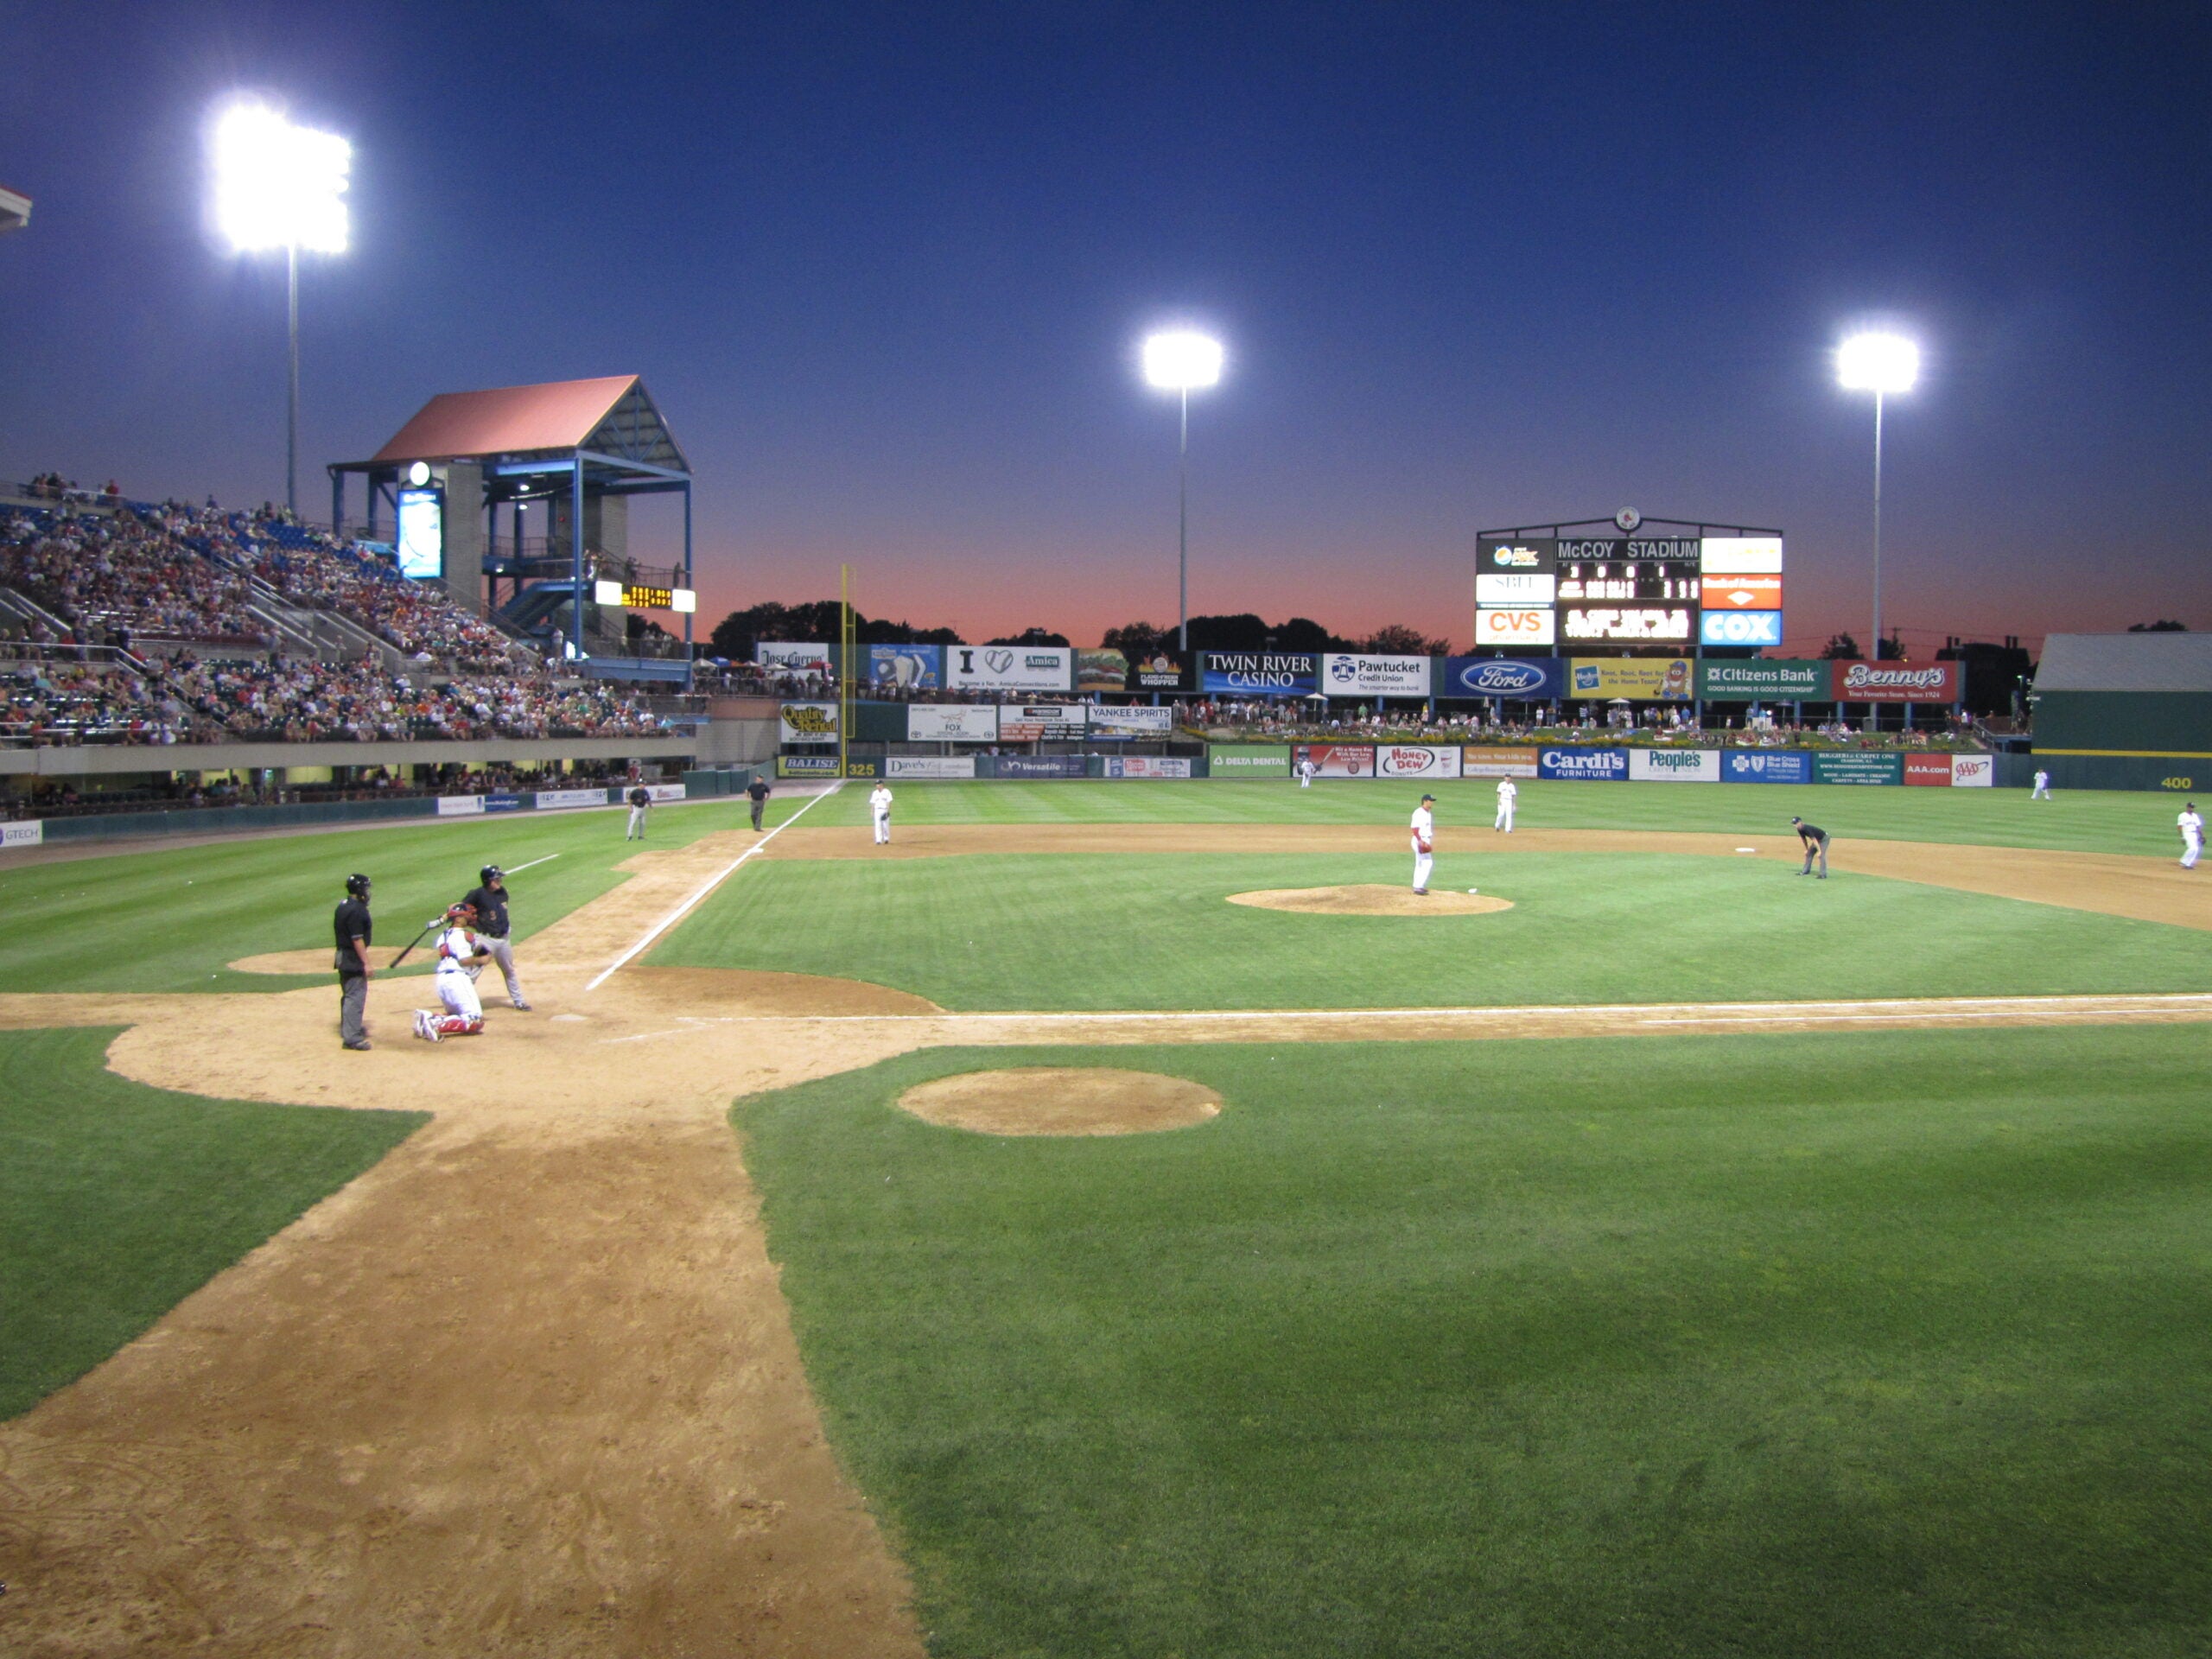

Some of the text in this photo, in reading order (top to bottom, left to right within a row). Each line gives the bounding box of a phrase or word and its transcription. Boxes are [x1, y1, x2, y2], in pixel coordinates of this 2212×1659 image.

[1558, 541, 1699, 558] McCOY STADIUM
[1489, 612, 1541, 632] CVS
[1704, 613, 1776, 642] COX
[959, 650, 974, 674] I
[1027, 656, 1058, 666] Amica
[1208, 654, 1313, 672] TWIN RIVER
[1358, 659, 1421, 673] Pawtucket
[1227, 671, 1294, 688] CASINO
[1382, 674, 1404, 683] Union
[1478, 666, 1528, 688] Ford
[1722, 668, 1815, 682] Citizens Bank
[1844, 664, 1944, 688] Benny's
[782, 705, 827, 727] Quality
[1093, 708, 1170, 717] YANKEE SPIRITS
[798, 718, 837, 732] Rental
[945, 723, 962, 732] FOX
[1391, 747, 1428, 761] HONEY
[1542, 751, 1624, 770] Cardi's
[786, 759, 838, 768] BALISE
[891, 760, 925, 772] Dave's
[1022, 762, 1061, 771] Versatile
[1225, 757, 1287, 766] DELTA DENTAL
[1396, 760, 1423, 770] DEW
[1649, 750, 1701, 772] People's
[849, 764, 875, 776] 325
[1556, 769, 1612, 778] FURNITURE
[1907, 766, 1949, 774] AAA.com
[1956, 762, 1978, 775] AAA
[2161, 777, 2192, 789] 400
[5, 829, 38, 840] GTECH
